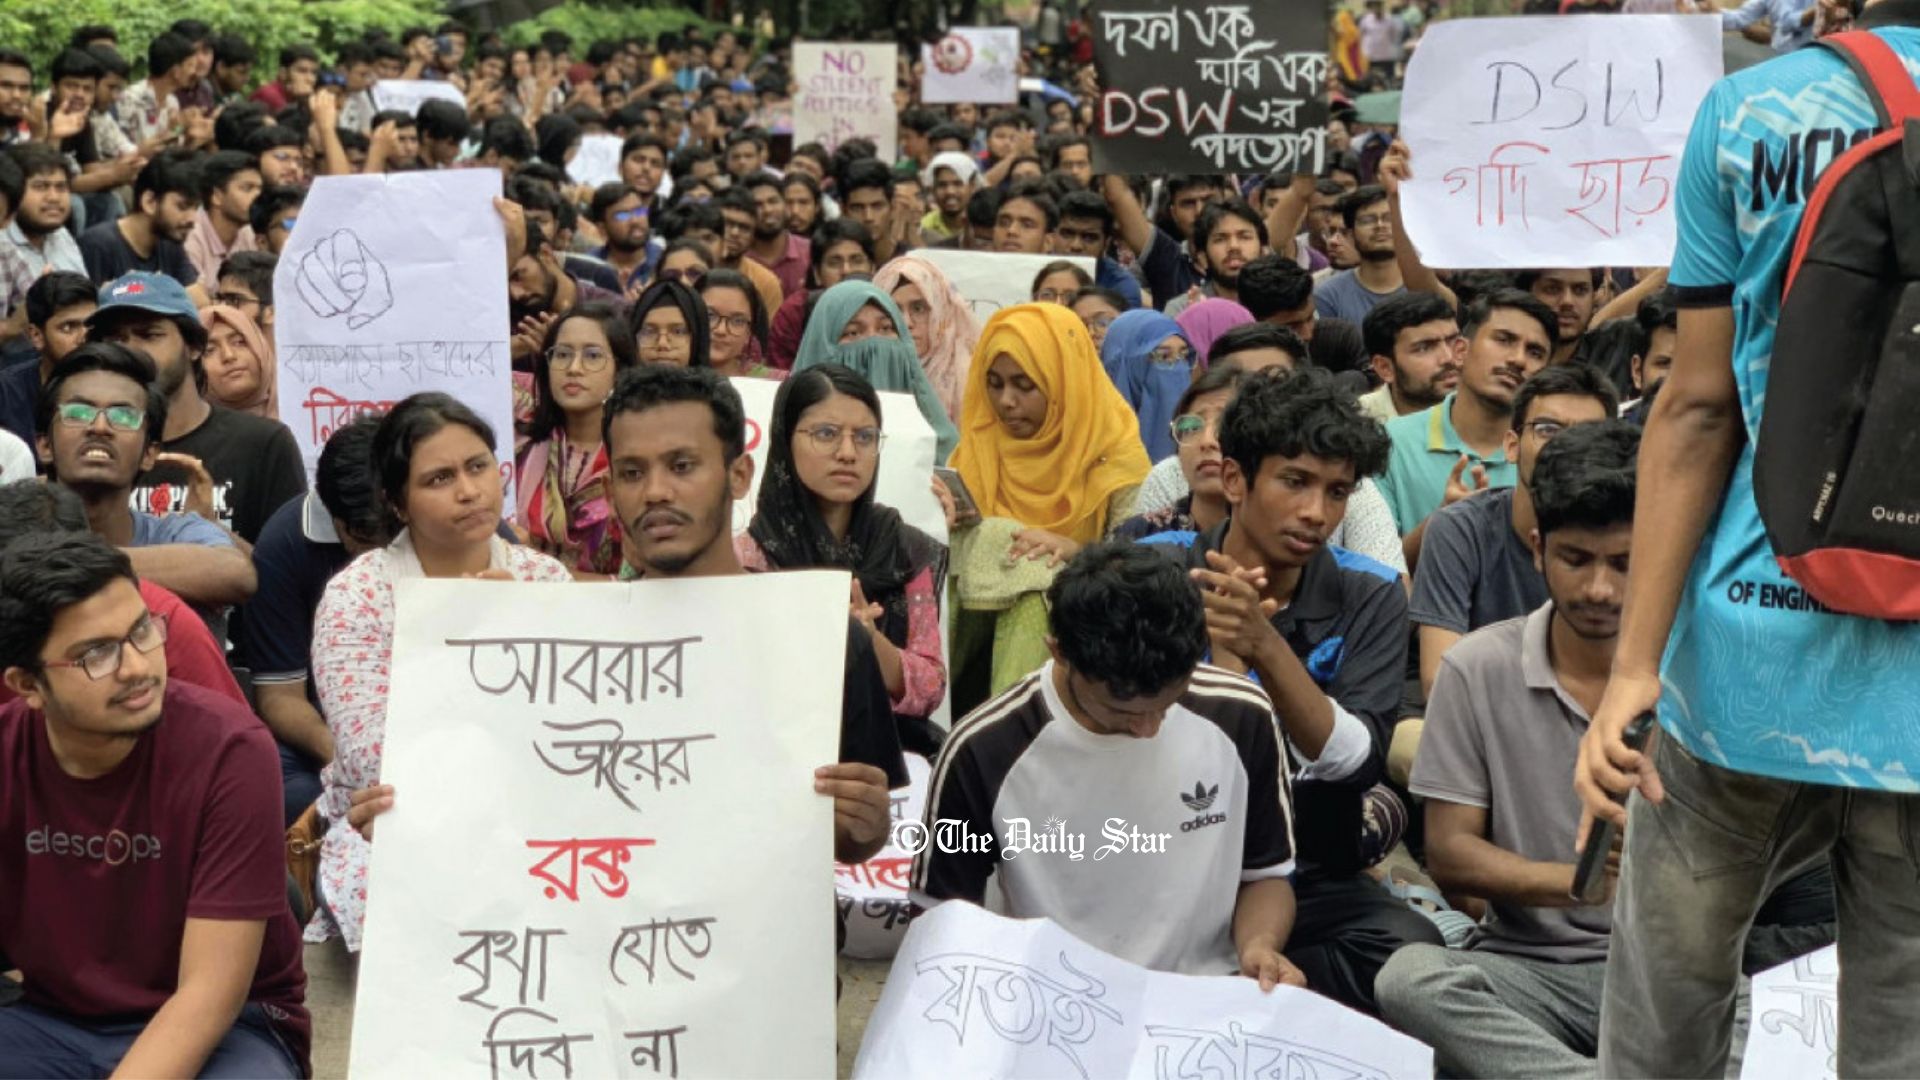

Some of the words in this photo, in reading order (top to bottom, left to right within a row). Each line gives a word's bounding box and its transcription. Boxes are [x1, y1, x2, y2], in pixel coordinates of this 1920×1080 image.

[1098, 6, 1179, 56] দফা
[1184, 6, 1255, 50] এক
[822, 50, 865, 75] NO
[1195, 39, 1278, 89] দাবি
[1264, 52, 1328, 96] এক
[1101, 87, 1233, 136] DSW
[1239, 98, 1306, 128] এর
[1469, 57, 1664, 130] DSW
[1190, 126, 1328, 175] পদত্যাগ
[1443, 140, 1550, 232] গদি
[1728, 580, 1756, 604] OF
[445, 636, 702, 704] আবরার
[1180, 812, 1226, 833] adidas
[526, 838, 656, 901] রক্ত
[453, 926, 567, 1010] বৃথা
[610, 917, 717, 986] যেতে
[623, 1025, 688, 1079] না
